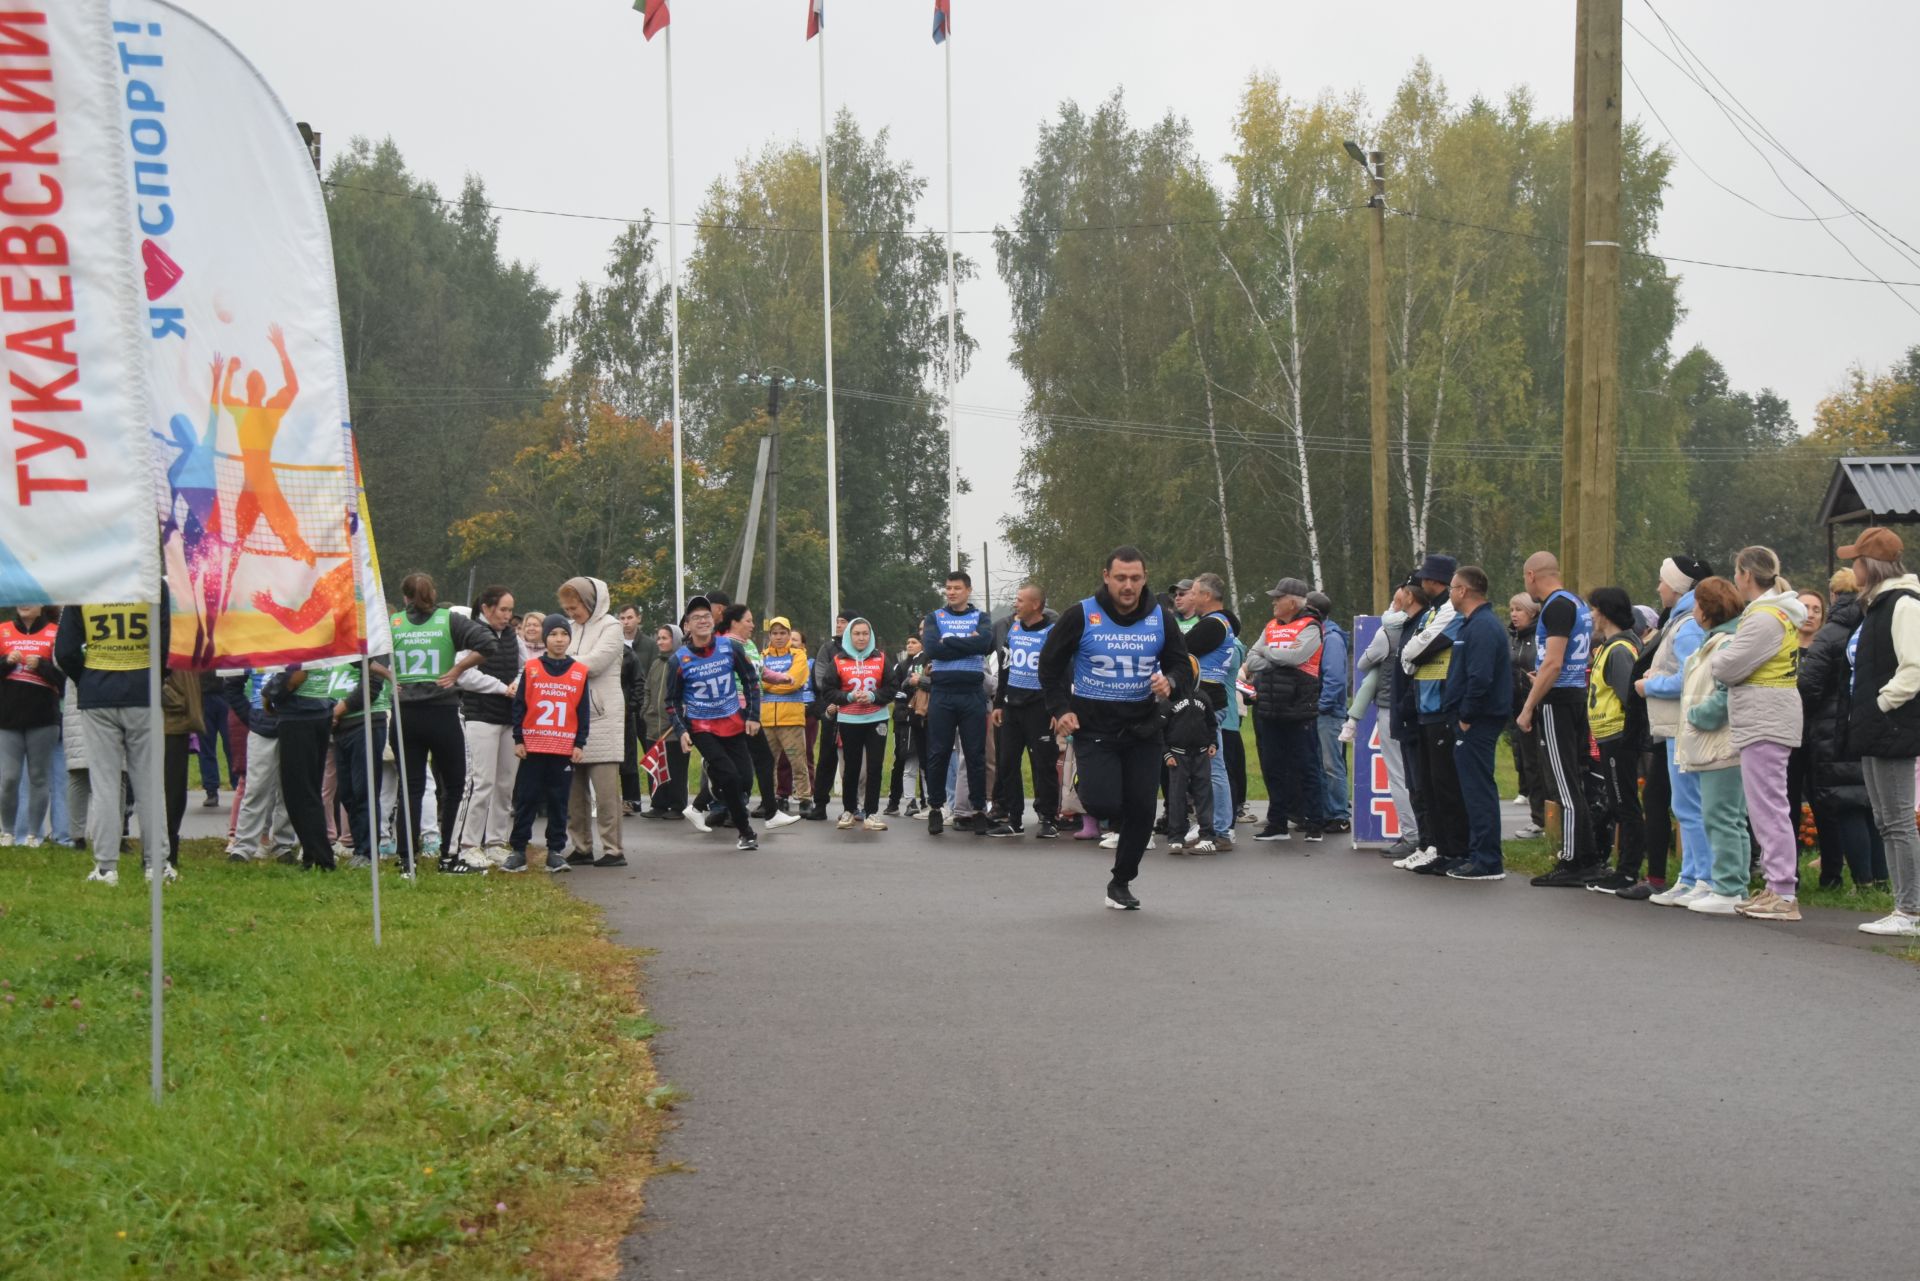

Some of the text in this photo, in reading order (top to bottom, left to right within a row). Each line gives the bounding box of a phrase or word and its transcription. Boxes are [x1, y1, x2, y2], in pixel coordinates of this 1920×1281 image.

[112, 20, 186, 340] Я СПОРТ!
[90, 612, 148, 641] 315
[1092, 633, 1157, 643] ТУКАЕВСКИЙ
[1107, 641, 1144, 650] РАЙОН
[394, 649, 440, 675] 121
[1009, 648, 1040, 670] 06
[1088, 654, 1156, 678] 215
[691, 672, 731, 699] 217
[536, 700, 567, 727] 21
